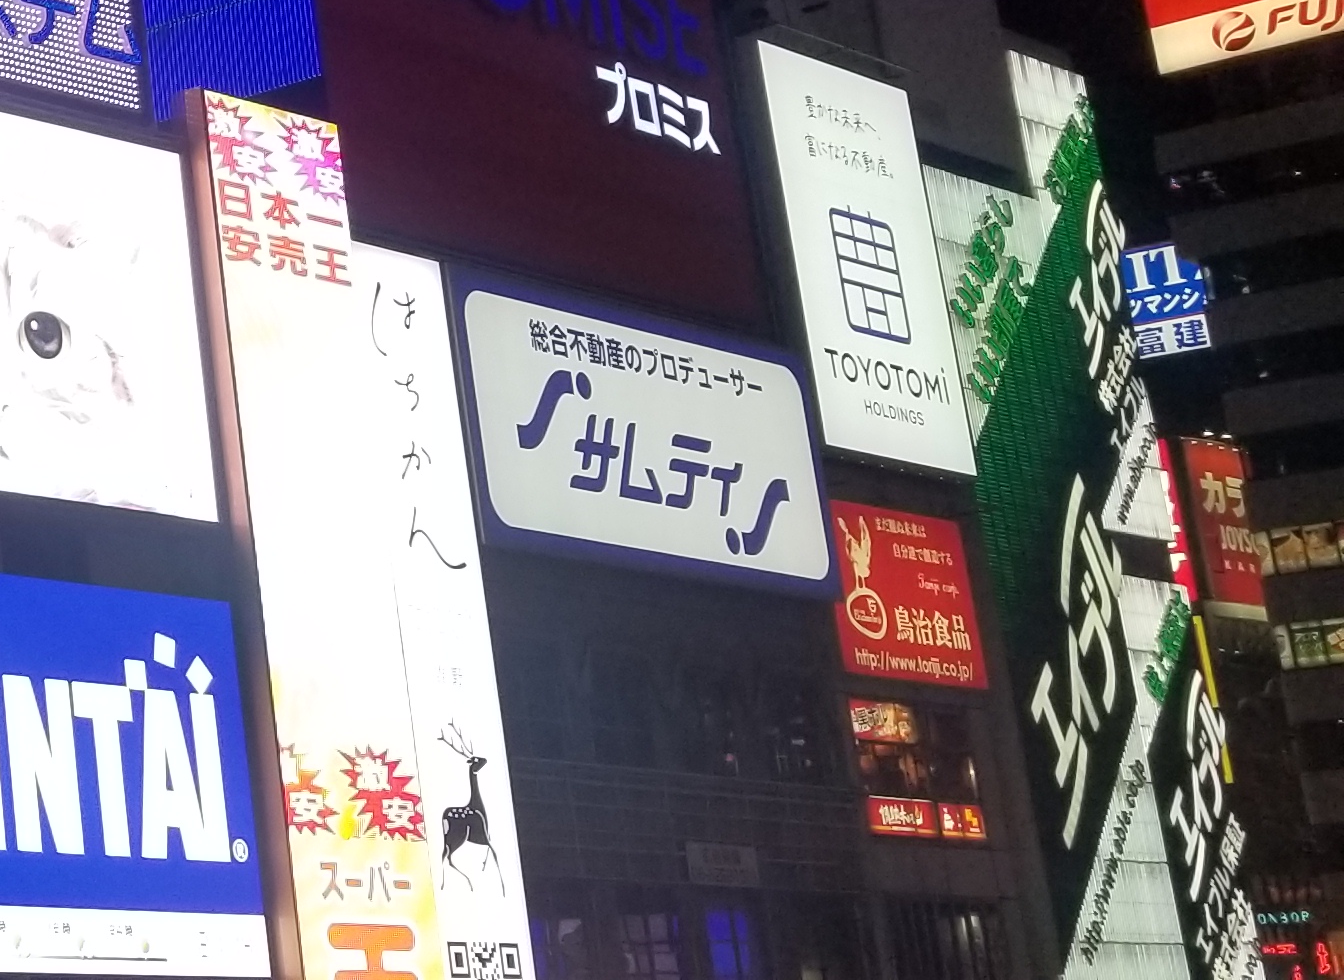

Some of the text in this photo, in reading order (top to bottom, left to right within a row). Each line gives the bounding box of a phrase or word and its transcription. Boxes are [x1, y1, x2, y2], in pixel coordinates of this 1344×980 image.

[595, 61, 722, 156] プロミス
[217, 177, 345, 229] 日本一
[221, 224, 353, 288] 安売王
[528, 318, 764, 398] 総合不動産のプロデューサー
[1098, 324, 1138, 415] 株式会社
[863, 399, 925, 427] HOLDINGS
[1110, 375, 1148, 461] エイブル
[893, 604, 972, 652] 鳥治食品
[319, 860, 413, 903] スーパー
[1195, 811, 1246, 965] エイブル保証
